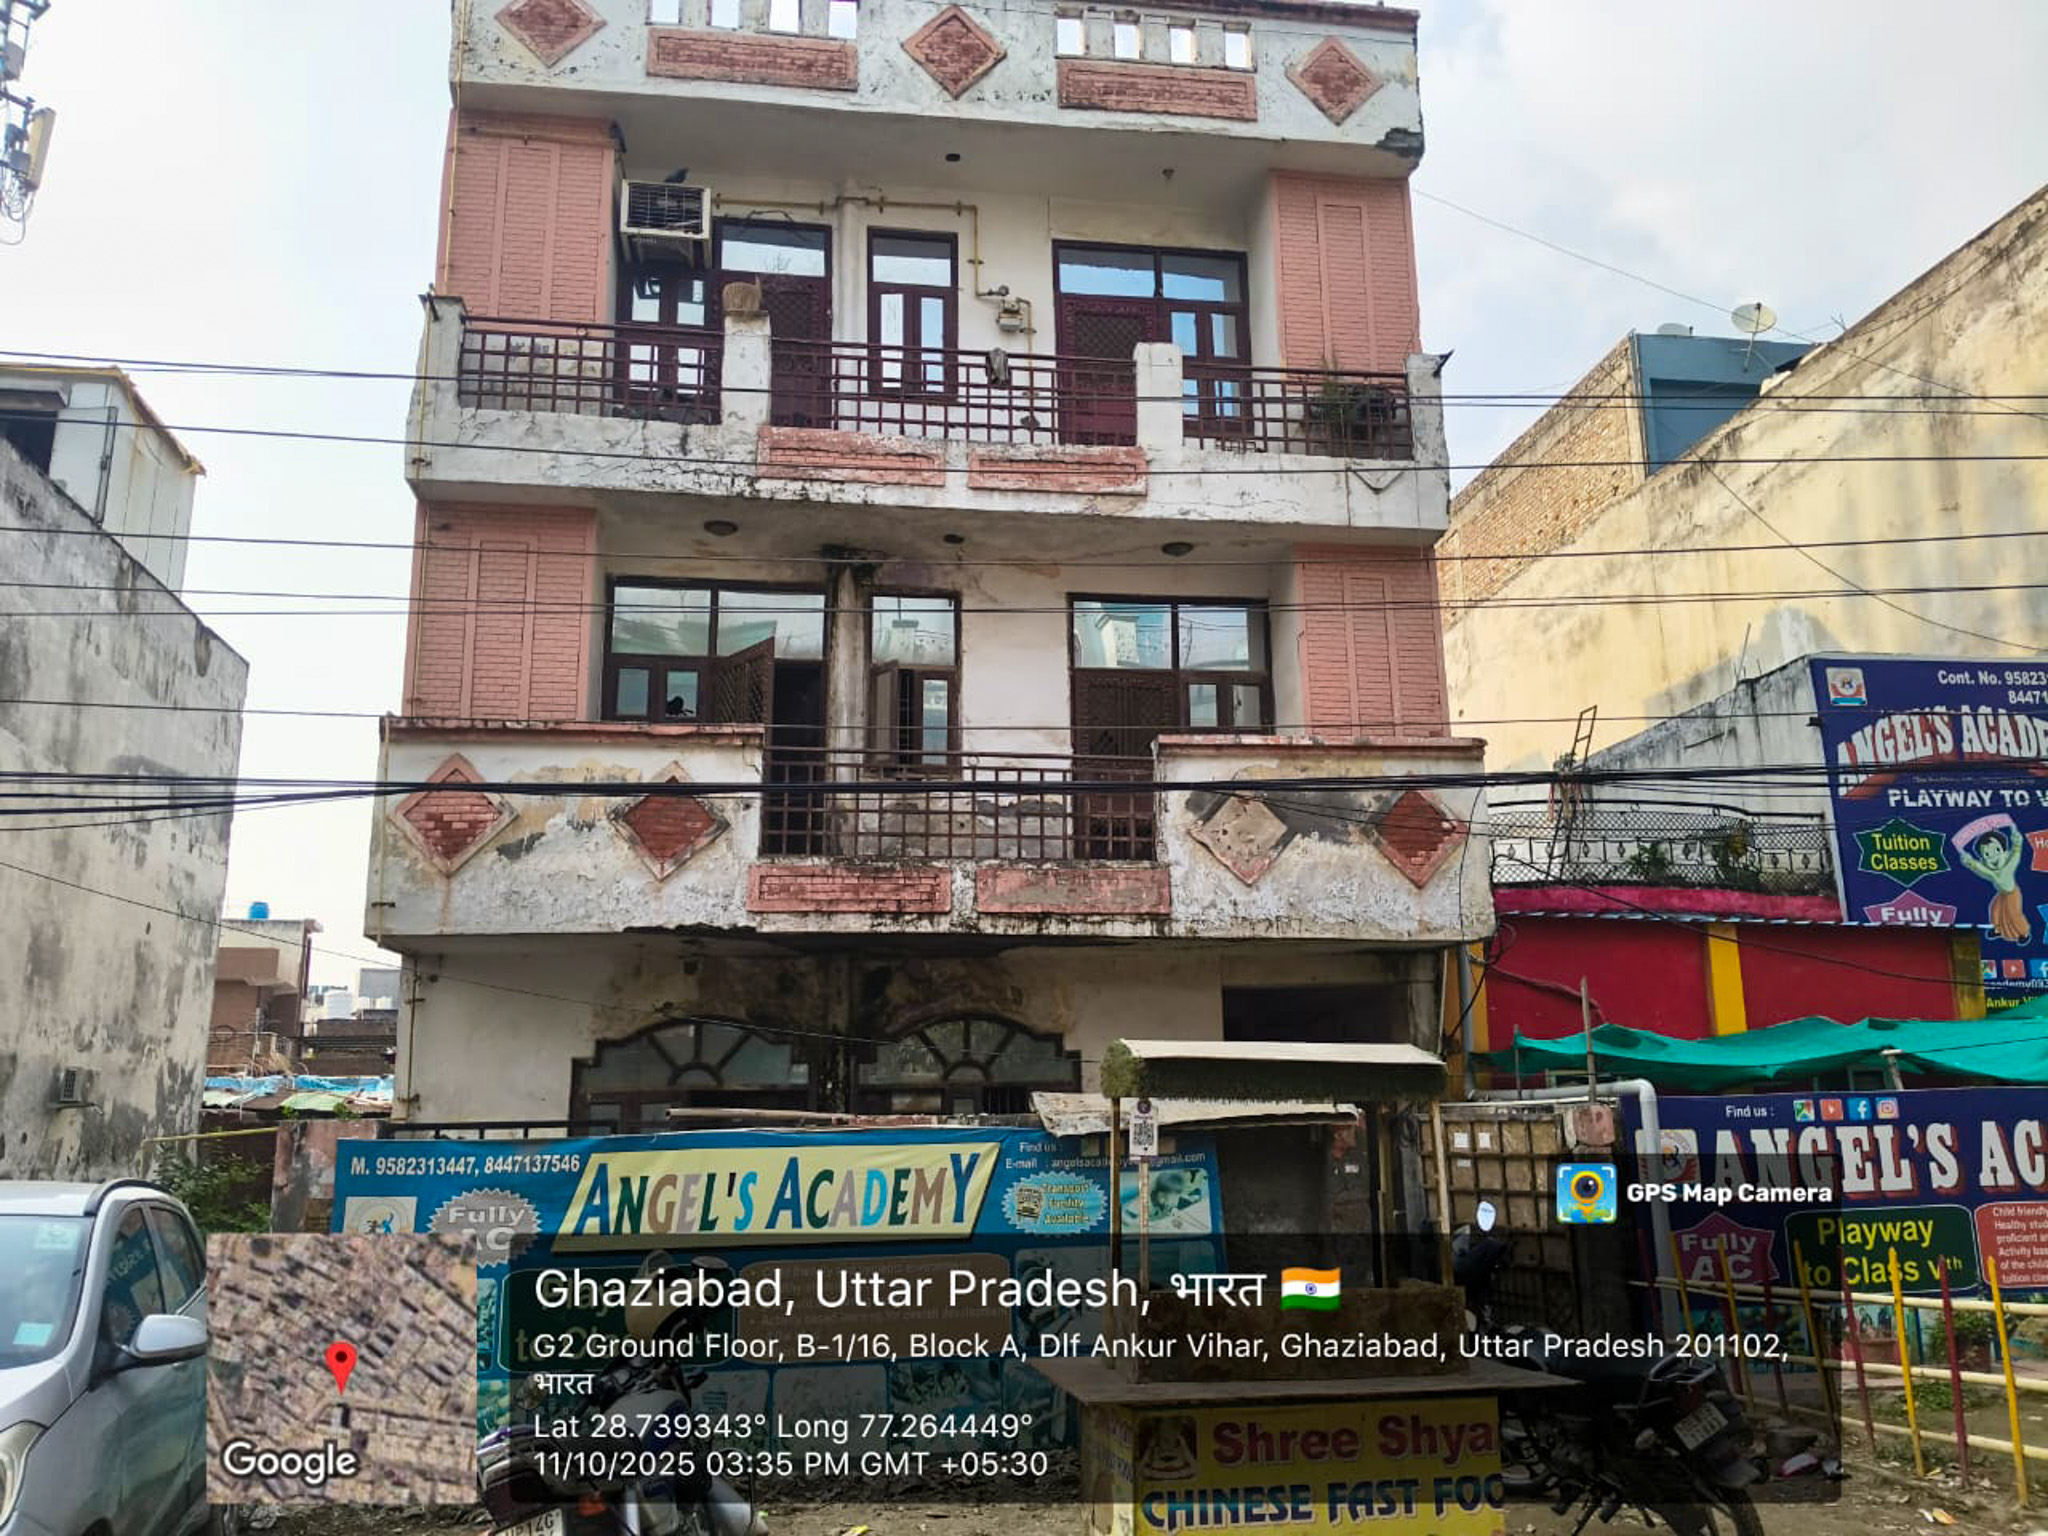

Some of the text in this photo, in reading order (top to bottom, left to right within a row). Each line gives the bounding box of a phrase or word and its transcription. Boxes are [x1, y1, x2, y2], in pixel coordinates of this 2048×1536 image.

[1937, 670, 1975, 685] Cont.
[1979, 671, 2001, 686] No.
[1888, 789, 1992, 807] PLAYWAY
[2000, 790, 2030, 807] TO
[1871, 833, 1931, 850] Tuition
[1871, 853, 1938, 871] Classes
[1881, 906, 1943, 924] Fully
[1726, 1105, 1752, 1118] Find
[1753, 1107, 1768, 1118] us
[351, 1155, 581, 1176] M. 9582313447, 8447137546
[1005, 1158, 1037, 1169] E-mail
[1715, 1122, 1961, 1198] ANGEL'S
[570, 1152, 981, 1238] ANGEL'S ACADEMY
[447, 1206, 525, 1226] Fully
[1682, 1233, 1757, 1254] Fully
[1817, 1217, 1934, 1251] Playway
[1691, 1254, 1754, 1281] AC
[1804, 1261, 1831, 1286] to
[1212, 1415, 1496, 1466] Shree Shya
[1141, 1483, 1314, 1532] CHINESE
[1326, 1478, 1420, 1524] FAST
